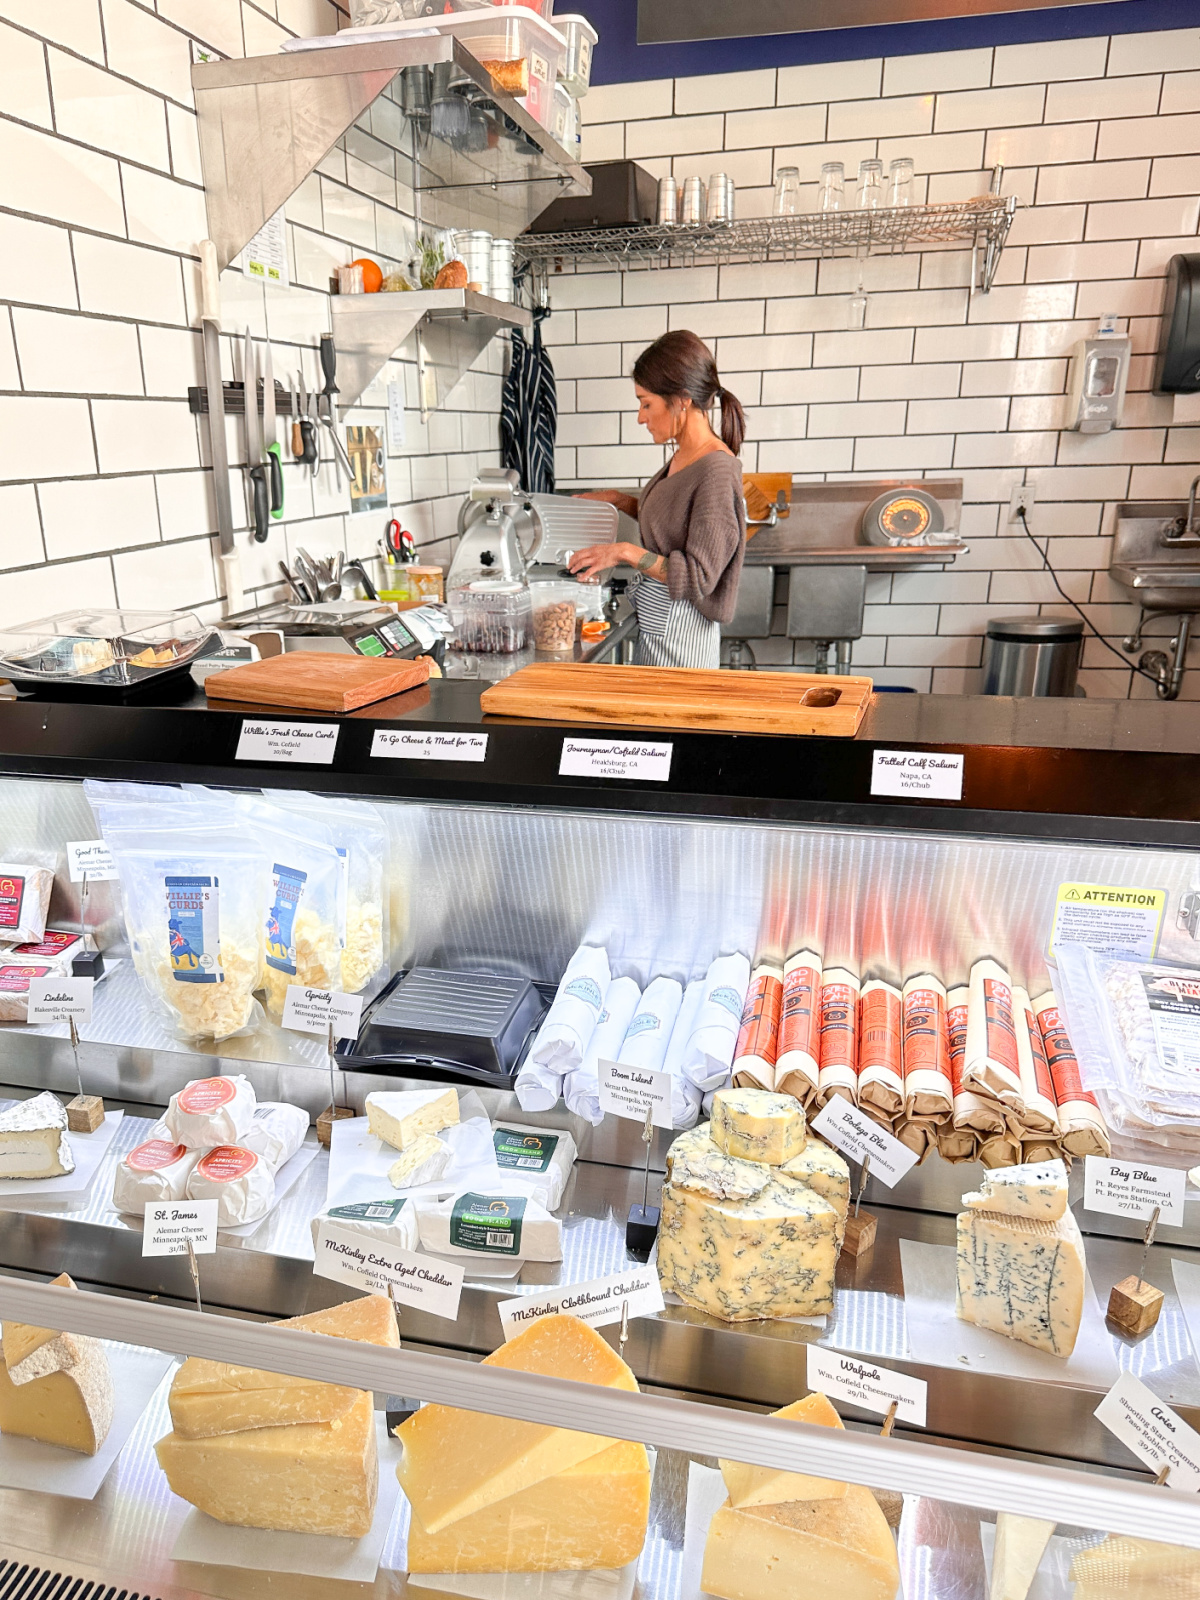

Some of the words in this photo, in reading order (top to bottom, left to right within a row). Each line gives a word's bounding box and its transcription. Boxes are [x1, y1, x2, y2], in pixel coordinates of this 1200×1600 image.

[244, 726, 269, 736] Willie's
[270, 728, 290, 737] Fresh
[292, 729, 314, 738] Cheese
[315, 730, 335, 739] Curds
[379, 734, 388, 742] To
[390, 735, 399, 745] Go
[401, 735, 424, 744] Cheese
[426, 736, 432, 744] &
[434, 737, 454, 745] Meat
[456, 738, 467, 747] for
[469, 738, 483, 746] Two
[567, 744, 640, 757] Journeyman/Cofield
[641, 748, 667, 757] Salumi
[878, 757, 907, 767] Fatted
[908, 758, 928, 770] Calf
[928, 759, 959, 769] Salumi
[900, 772, 921, 780] Napa,
[901, 781, 931, 789] 16/Chub
[75, 847, 91, 858] Good
[276, 889, 299, 903] CURDS
[1084, 891, 1156, 906] ATTENTION
[169, 901, 204, 910] CURDS
[43, 993, 74, 1002] Lindeline
[305, 990, 332, 1004] Apricity
[294, 1009, 327, 1020] Minneapolis,
[311, 1004, 329, 1012] Cheese
[329, 1007, 354, 1017] Company
[611, 1068, 629, 1080] Boom
[631, 1072, 653, 1085] Island
[611, 1092, 642, 1106] Minneapolis,
[643, 1099, 653, 1107] MN
[621, 1086, 639, 1095] Cheese
[640, 1090, 664, 1102] Company
[842, 1112, 869, 1138] Bodega
[869, 1133, 888, 1152] Blue
[840, 1139, 859, 1155] 31/Lb.
[857, 1141, 896, 1173] Cheesemakers
[1110, 1166, 1130, 1182] Bay
[1132, 1170, 1158, 1182] Blue
[1107, 1181, 1129, 1191] Reyes
[1131, 1185, 1171, 1198] Farmstead
[1095, 1188, 1105, 1196] Pt.
[1107, 1190, 1129, 1200] Reyes
[1130, 1194, 1160, 1206] Station,
[1161, 1199, 1173, 1208] CA
[1118, 1202, 1143, 1211] 27/Lb.
[154, 1210, 168, 1220] St.
[171, 1210, 198, 1220] James
[152, 1235, 194, 1244] Minneapolis,
[325, 1239, 366, 1264] McKinley
[367, 1253, 392, 1269] Extra
[394, 1262, 418, 1277] Aged
[417, 1269, 453, 1287] Cheddar
[341, 1260, 356, 1271] Wm.
[356, 1266, 379, 1280] Cofield
[379, 1273, 423, 1293] Cheesemakers
[365, 1279, 386, 1290] 32/Lb.
[511, 1303, 559, 1322] McKinley
[561, 1286, 611, 1310] Clothbound
[612, 1280, 650, 1297] Cheddar
[575, 1304, 620, 1320] heesemakers
[840, 1360, 881, 1381] Walpole
[818, 1368, 835, 1381] Wm.
[836, 1375, 862, 1389] Cofield
[862, 1383, 915, 1405] Cheesemakers
[847, 1388, 869, 1401] 29/lb.
[1151, 1407, 1177, 1433] Aries
[1119, 1397, 1151, 1429] Shooting
[1150, 1425, 1167, 1441] Star
[1166, 1440, 1200, 1474] Creamery
[1124, 1414, 1142, 1432] Paso
[1142, 1430, 1168, 1457] Robles,
[1168, 1454, 1180, 1468] CA
[1137, 1439, 1160, 1461] 39/lb.
